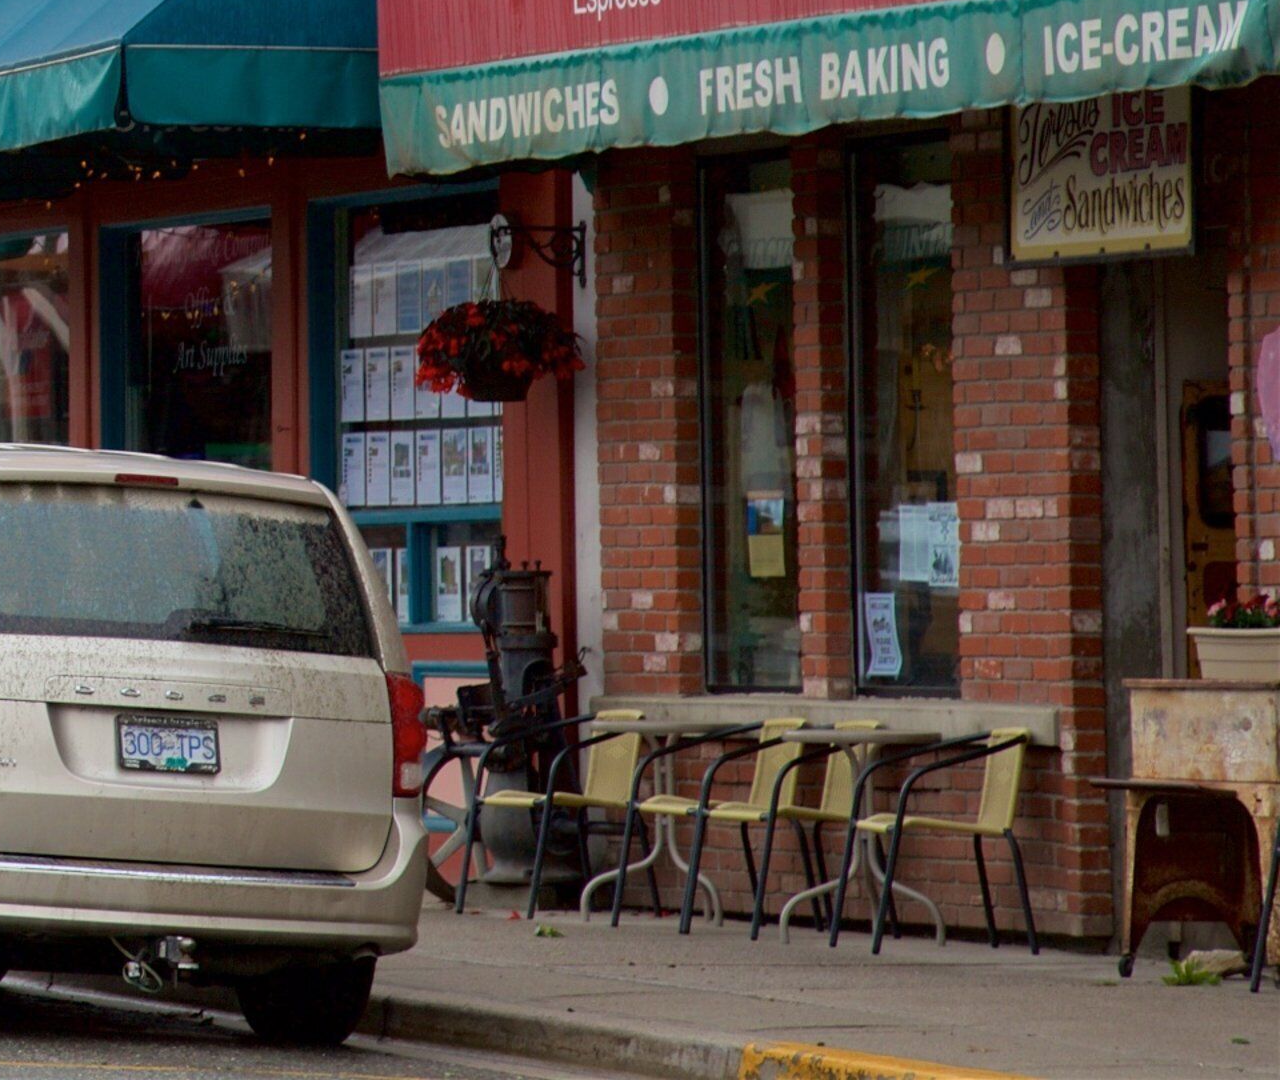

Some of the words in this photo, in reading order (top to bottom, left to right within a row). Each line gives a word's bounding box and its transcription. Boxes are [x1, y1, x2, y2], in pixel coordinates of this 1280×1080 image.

[435, 79, 620, 149] SANDWICHES
[699, 56, 802, 116] FRESH
[819, 37, 950, 103] BAKING
[1111, 89, 1165, 127] ICE
[1090, 122, 1188, 177] CREAM
[1063, 172, 1185, 234] Sandwiches
[124, 731, 162, 757] 300
[175, 733, 215, 760] TPS
